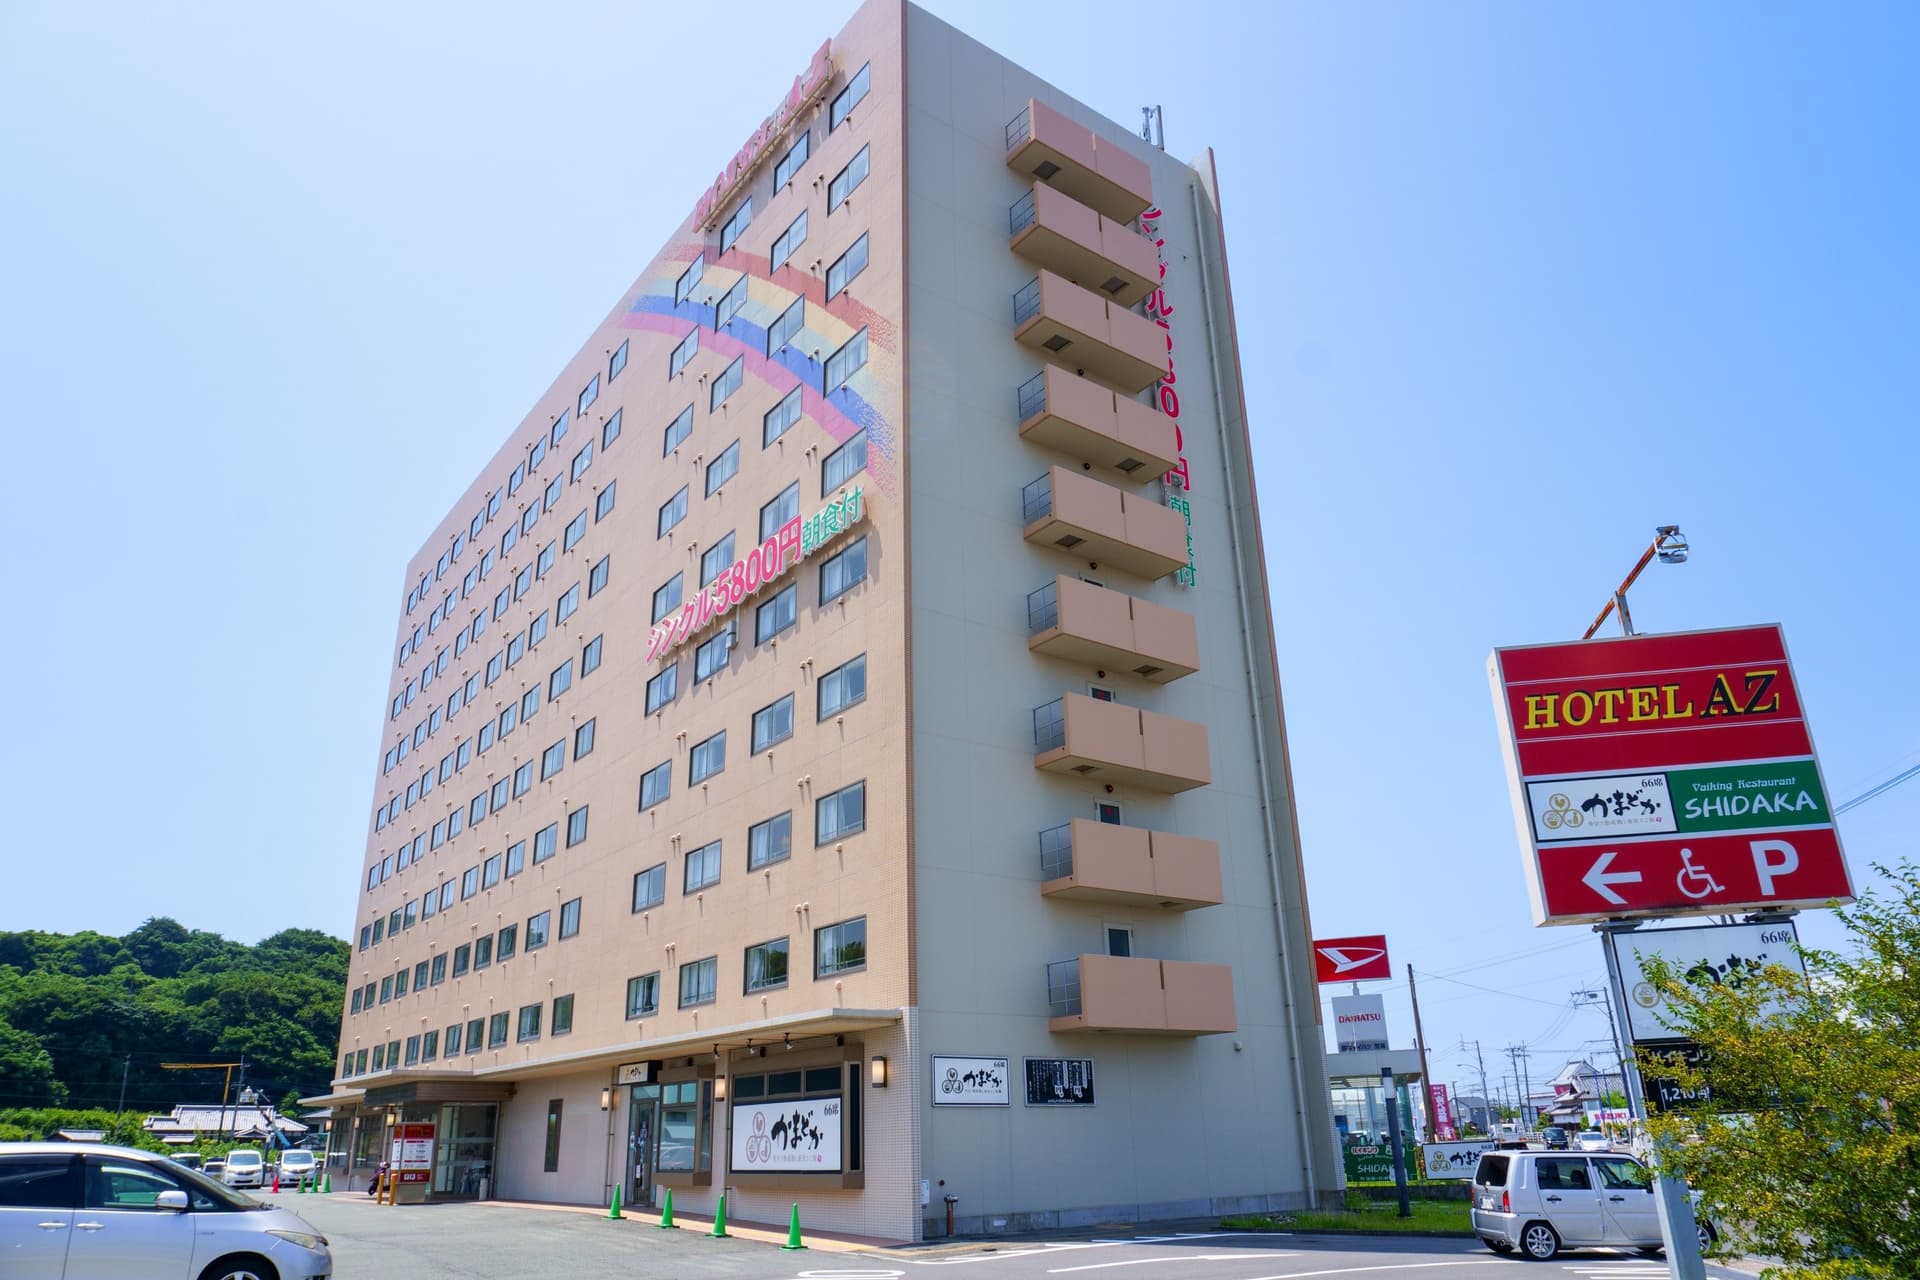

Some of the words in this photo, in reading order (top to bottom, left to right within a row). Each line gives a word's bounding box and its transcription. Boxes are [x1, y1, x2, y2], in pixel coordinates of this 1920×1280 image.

[1524, 684, 1694, 730] HOTEL
[1700, 670, 1779, 719] AZ
[1692, 781, 1732, 792] Vaiking
[1738, 777, 1796, 789] Restaurant
[1581, 789, 1661, 818] かまどか
[1685, 790, 1818, 819] SHIDAKA
[1750, 840, 1799, 896] P
[963, 1068, 1002, 1088] かまどか
[771, 1109, 823, 1150] かまどか
[1357, 1164, 1395, 1173] SHIDA
[1450, 1150, 1483, 1166] かまど
